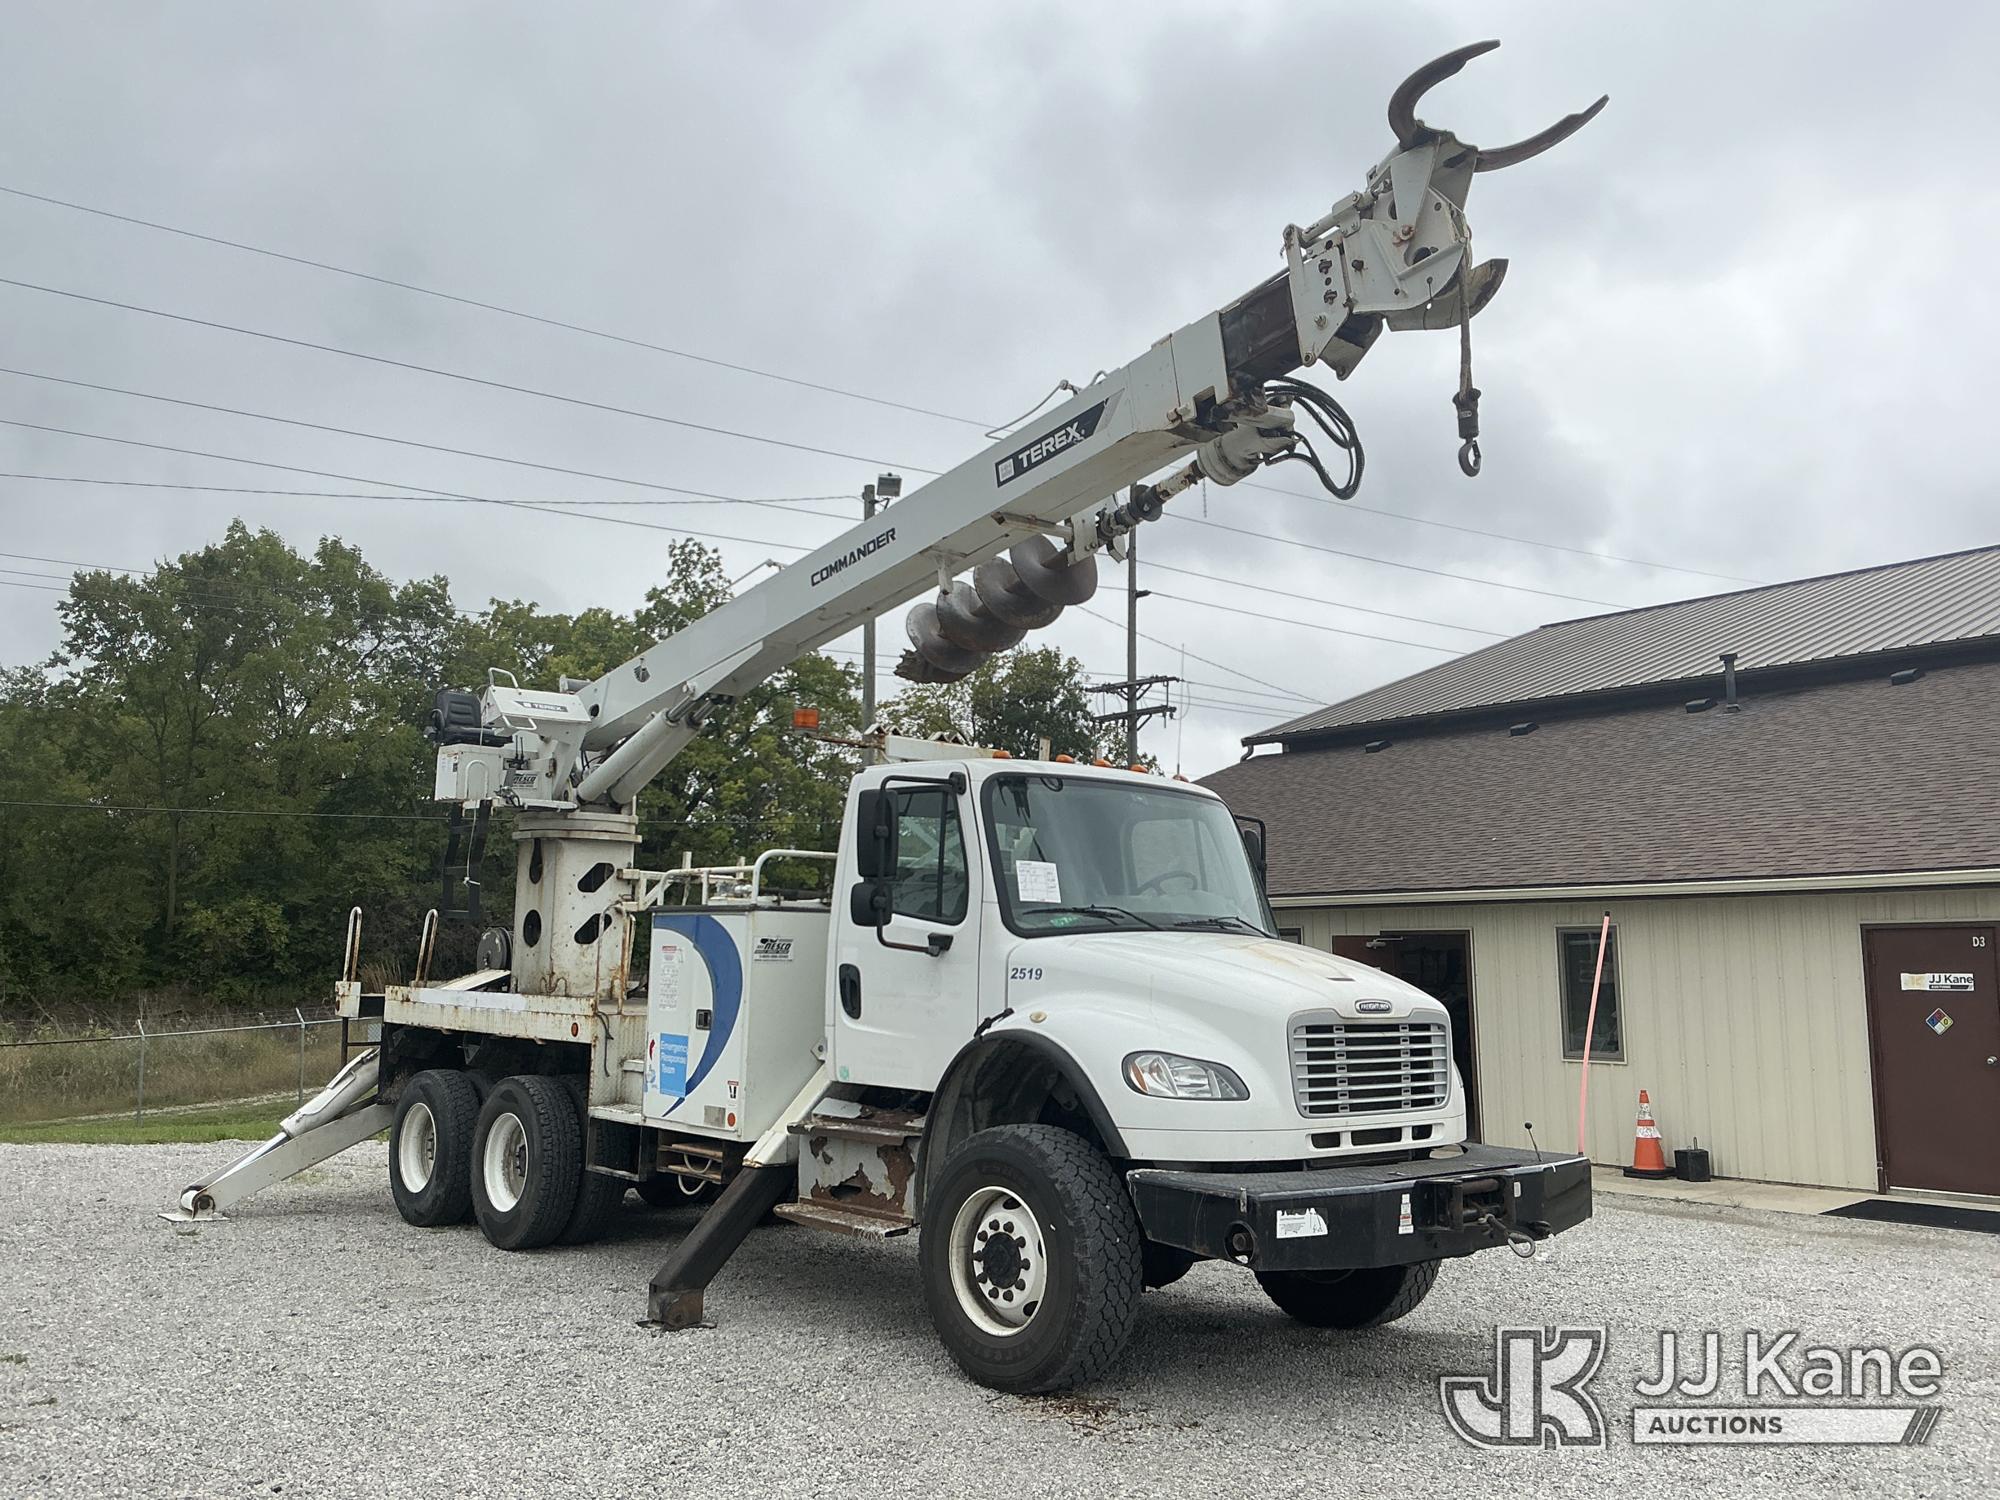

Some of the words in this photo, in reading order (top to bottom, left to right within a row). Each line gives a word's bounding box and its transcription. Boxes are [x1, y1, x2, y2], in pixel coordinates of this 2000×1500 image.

[1018, 421, 1081, 468] TEREX
[810, 527, 896, 587] COMMANDER
[1972, 936, 1986, 947] D3
[1010, 967, 1043, 981] 2519
[1929, 974, 1941, 983] JJ
[1944, 974, 1973, 983] Kane
